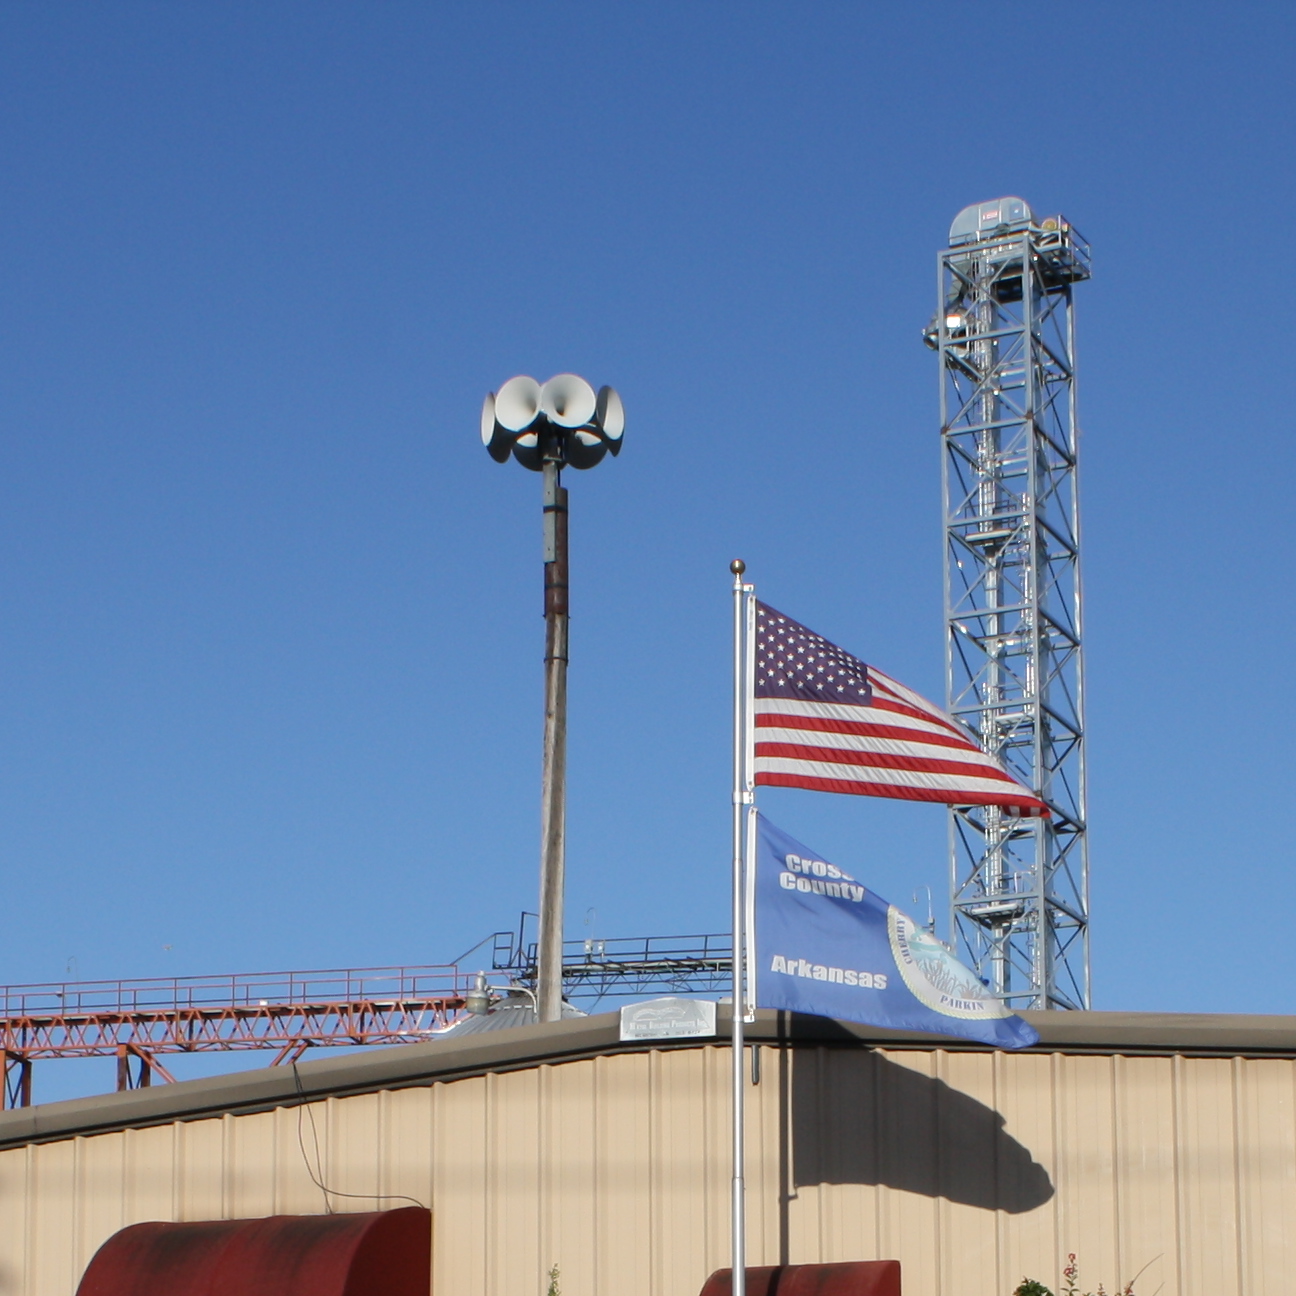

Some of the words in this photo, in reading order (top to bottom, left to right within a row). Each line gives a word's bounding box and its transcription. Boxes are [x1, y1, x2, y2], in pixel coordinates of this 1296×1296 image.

[779, 871, 865, 903] County
[770, 954, 888, 990] Arkansas
[939, 995, 985, 1011] PARKIN
